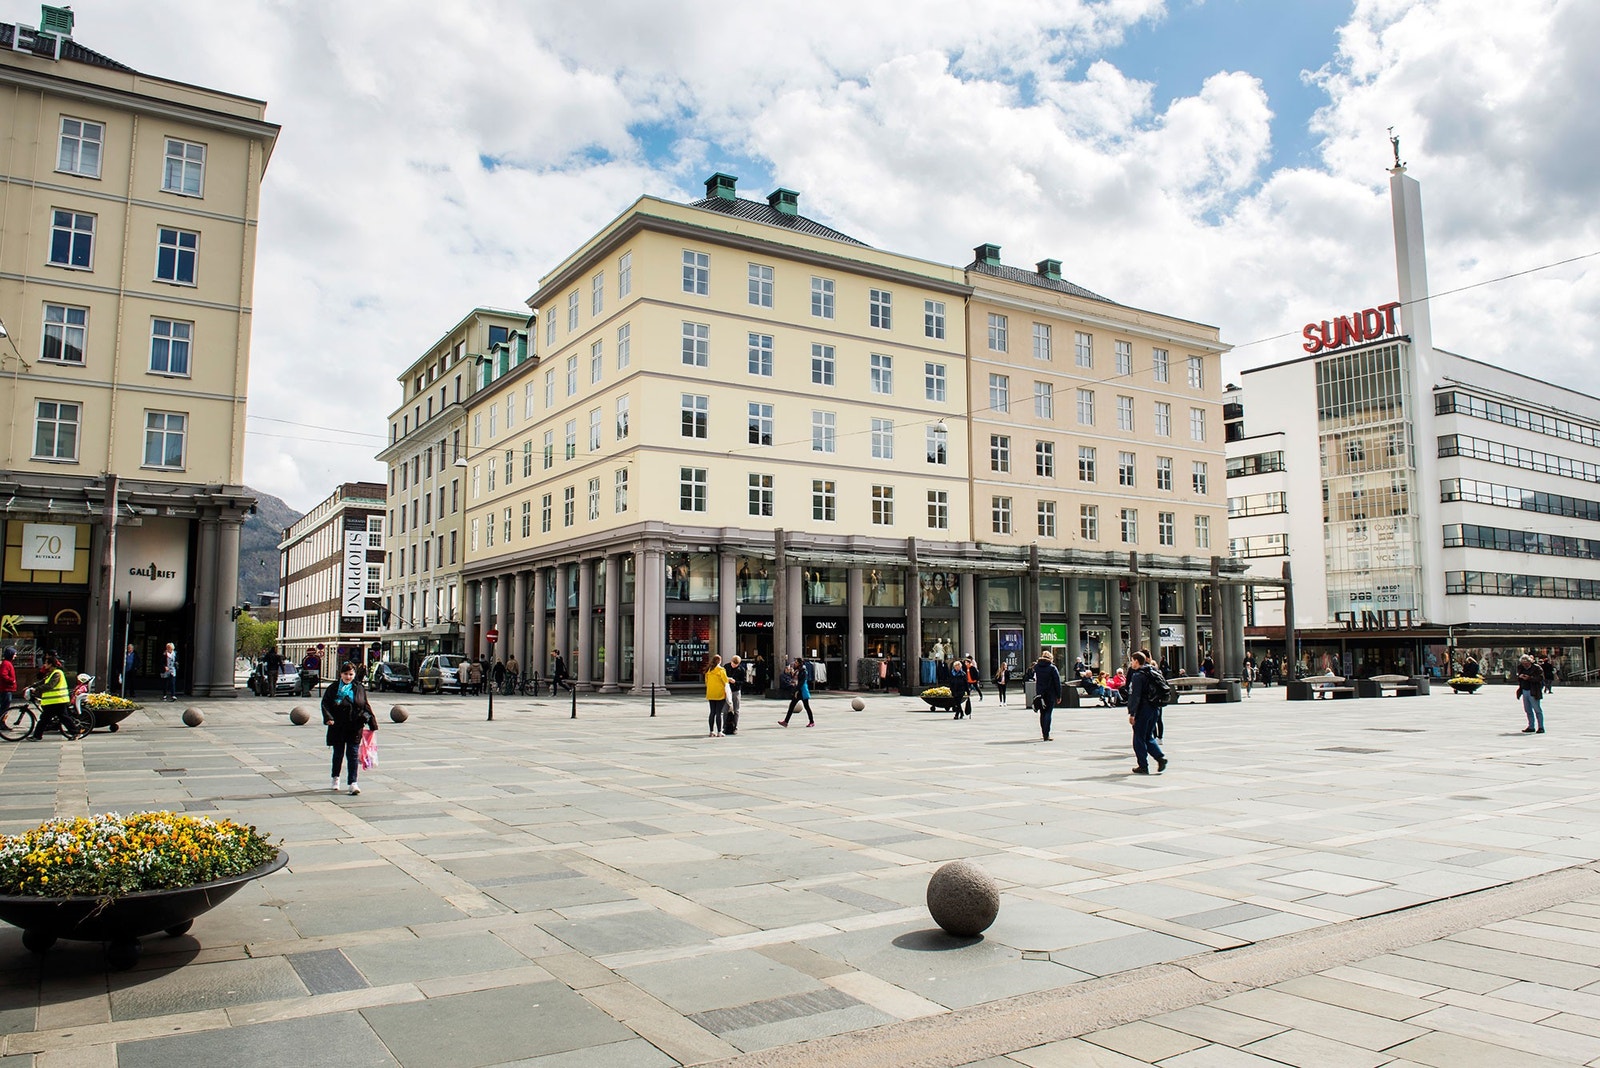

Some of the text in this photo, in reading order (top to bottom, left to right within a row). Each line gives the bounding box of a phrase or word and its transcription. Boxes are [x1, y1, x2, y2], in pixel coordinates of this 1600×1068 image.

[1303, 302, 1401, 353] SUNDT
[36, 535, 61, 554] 70
[347, 533, 362, 614] SHOPPING
[1335, 608, 1418, 631] SUNDT
